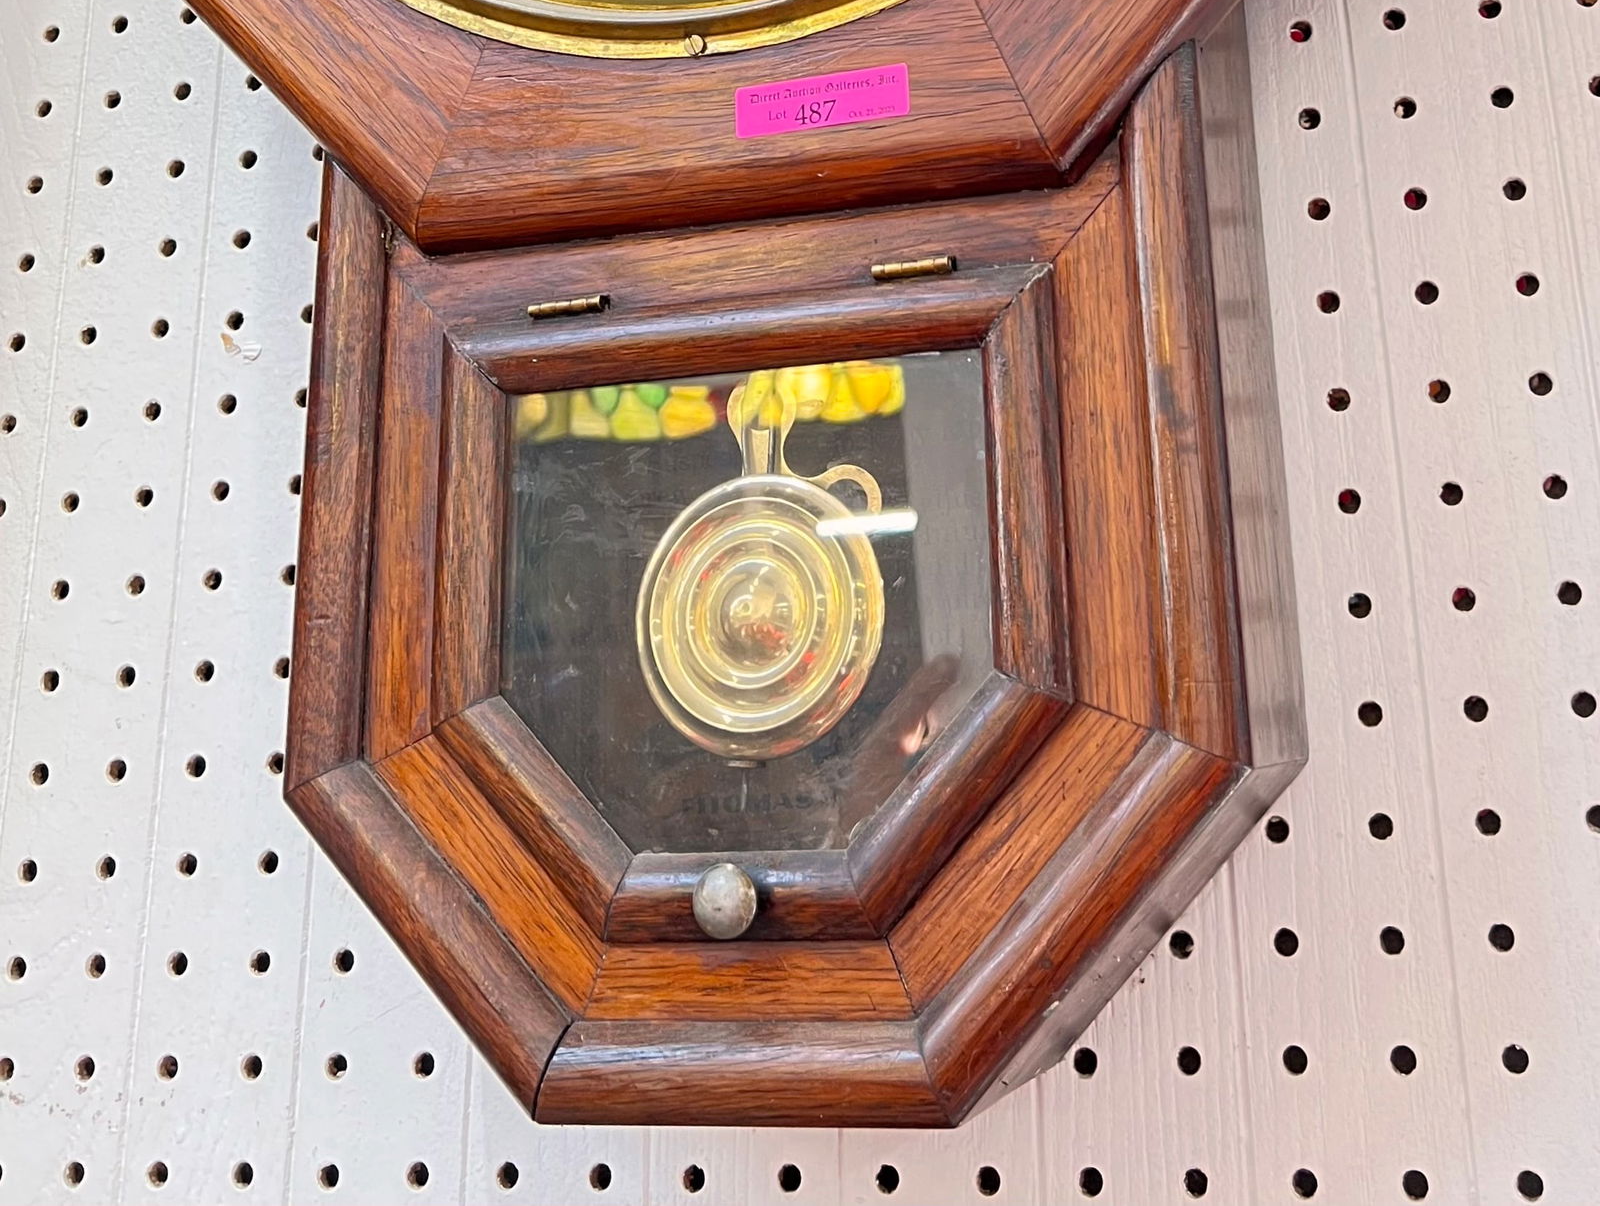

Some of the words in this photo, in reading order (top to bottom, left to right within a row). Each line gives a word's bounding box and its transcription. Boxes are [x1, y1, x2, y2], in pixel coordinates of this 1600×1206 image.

[750, 92, 781, 105] Direct
[783, 87, 822, 100] Auction
[768, 109, 787, 122] Lot
[794, 99, 837, 125] 487
